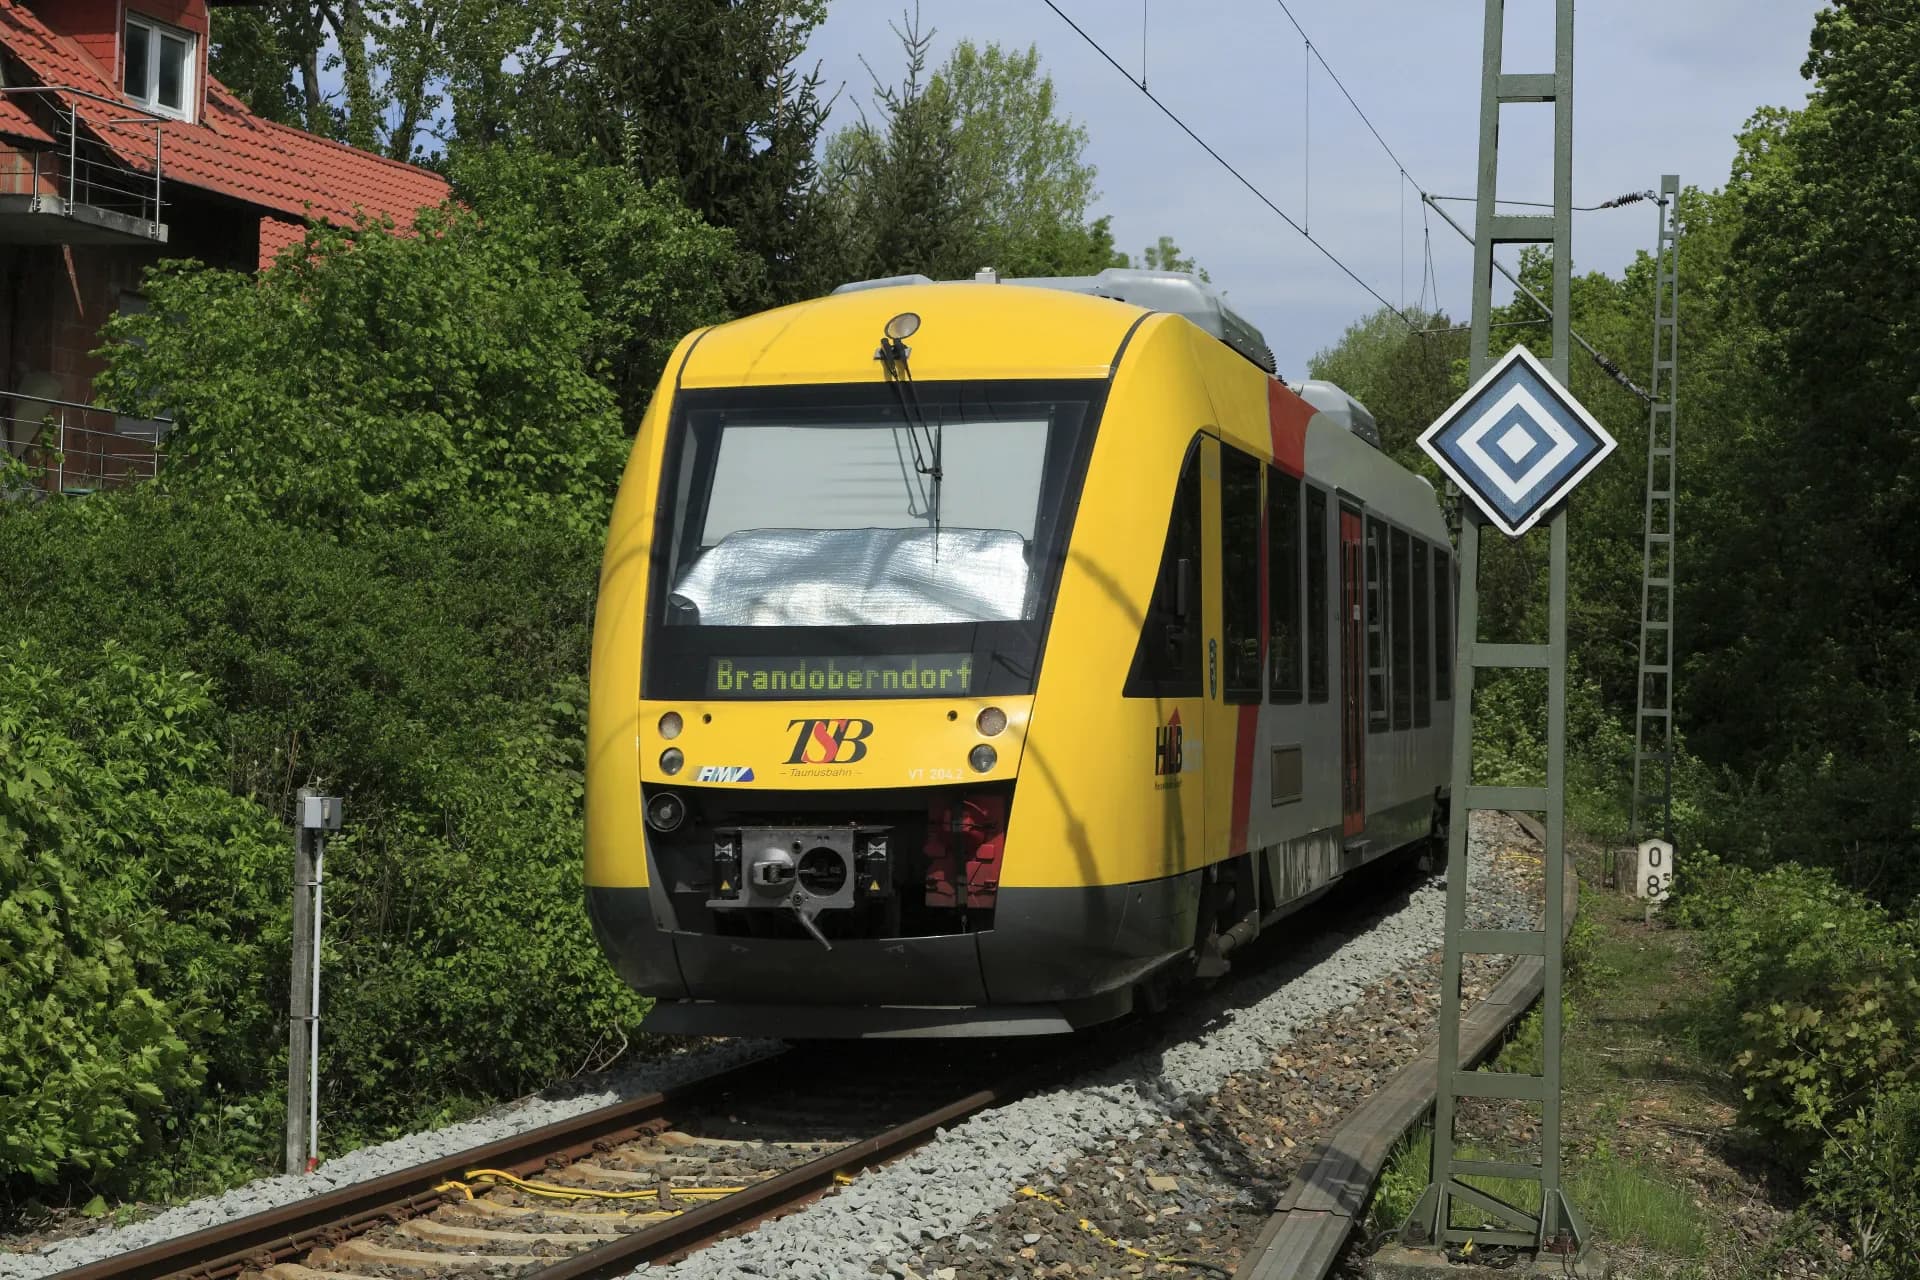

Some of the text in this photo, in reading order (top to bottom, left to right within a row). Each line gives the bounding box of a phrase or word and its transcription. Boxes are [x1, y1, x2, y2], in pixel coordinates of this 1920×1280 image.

[717, 657, 971, 690] Brandoberndorf
[781, 718, 874, 765] TSB
[789, 767, 853, 778] Taunusbahn
[908, 767, 924, 781] VT
[1649, 847, 1661, 867] 0
[1647, 875, 1659, 897] 8
